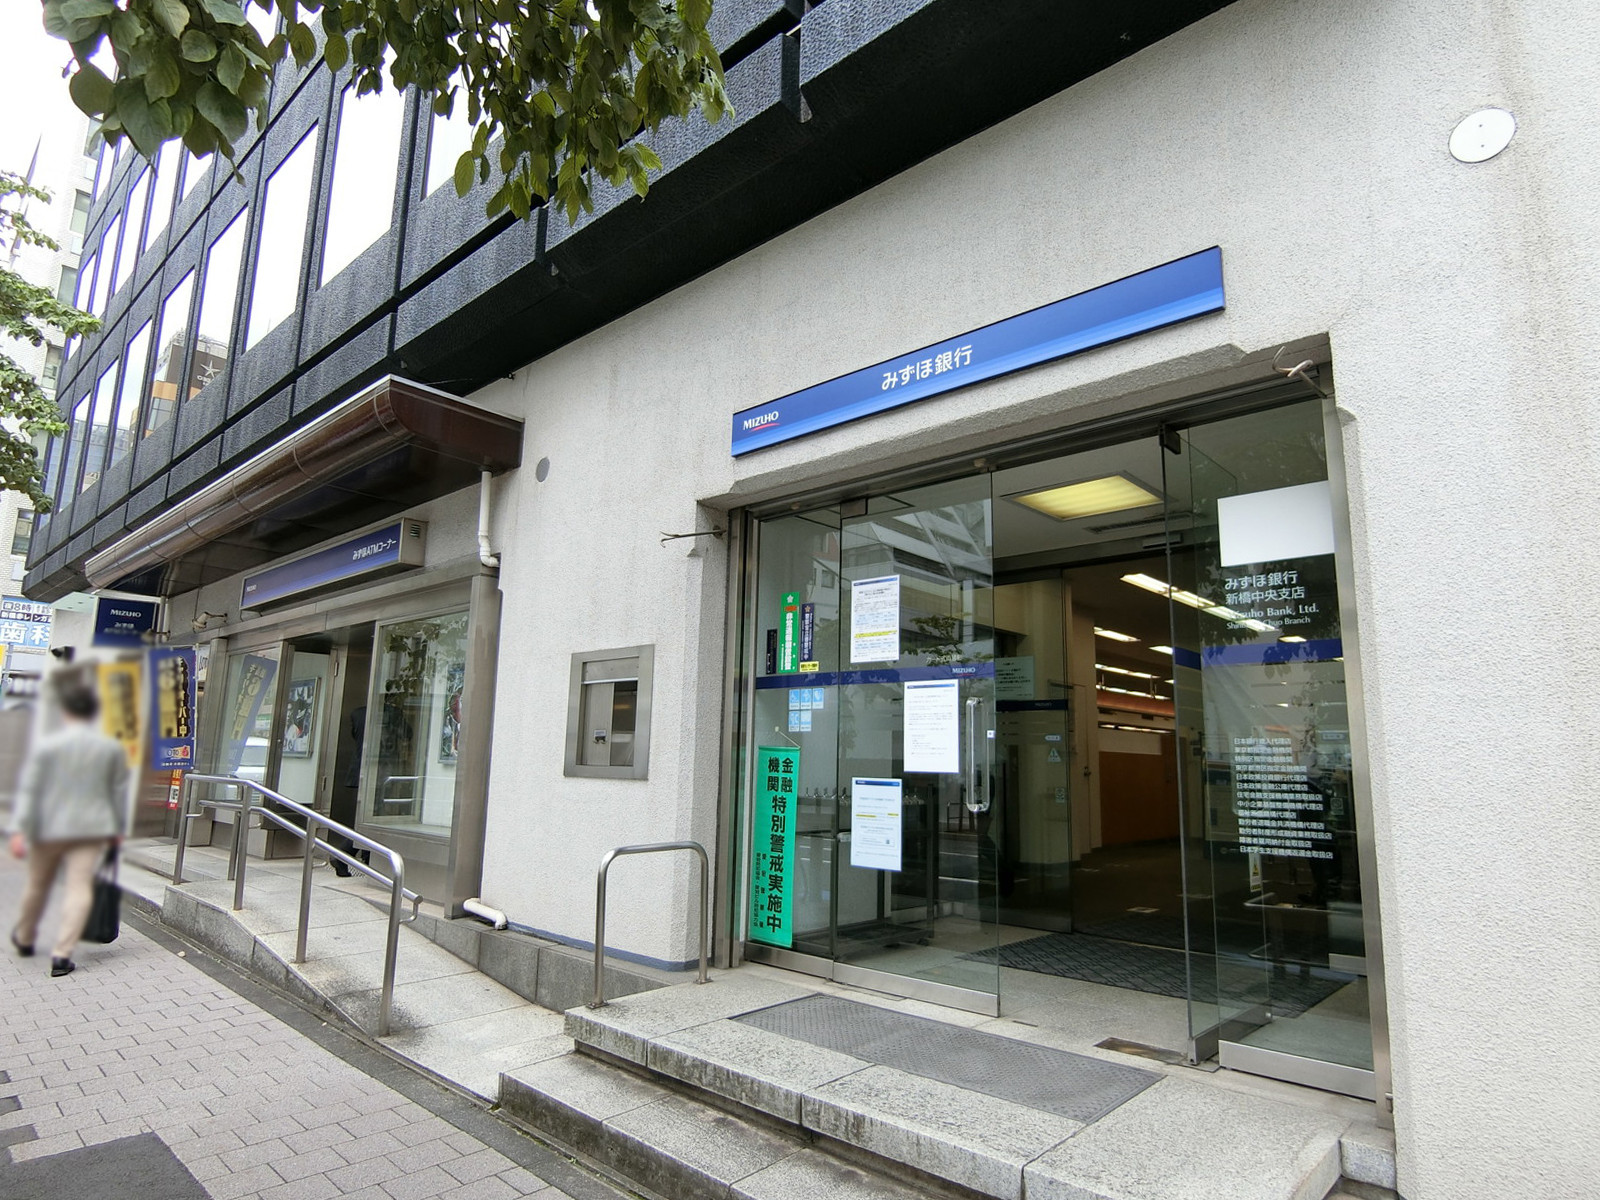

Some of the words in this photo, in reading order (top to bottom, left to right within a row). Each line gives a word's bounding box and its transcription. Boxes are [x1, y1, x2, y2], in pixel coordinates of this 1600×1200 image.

[881, 344, 973, 391] みずほ銀行
[743, 410, 780, 430] MIZUHO
[352, 538, 397, 560] みずほATMコーナー
[1224, 570, 1299, 590] みずほ銀行
[1225, 586, 1306, 605] 新橋中央支店
[109, 608, 142, 618] MIZUHO
[1266, 605, 1296, 617] Bank,
[1299, 602, 1320, 614] Ltd.
[1284, 616, 1311, 625] Branch
[767, 756, 780, 793] 機関
[781, 757, 793, 793] 金融
[766, 795, 787, 933] 特別警戒実施中
